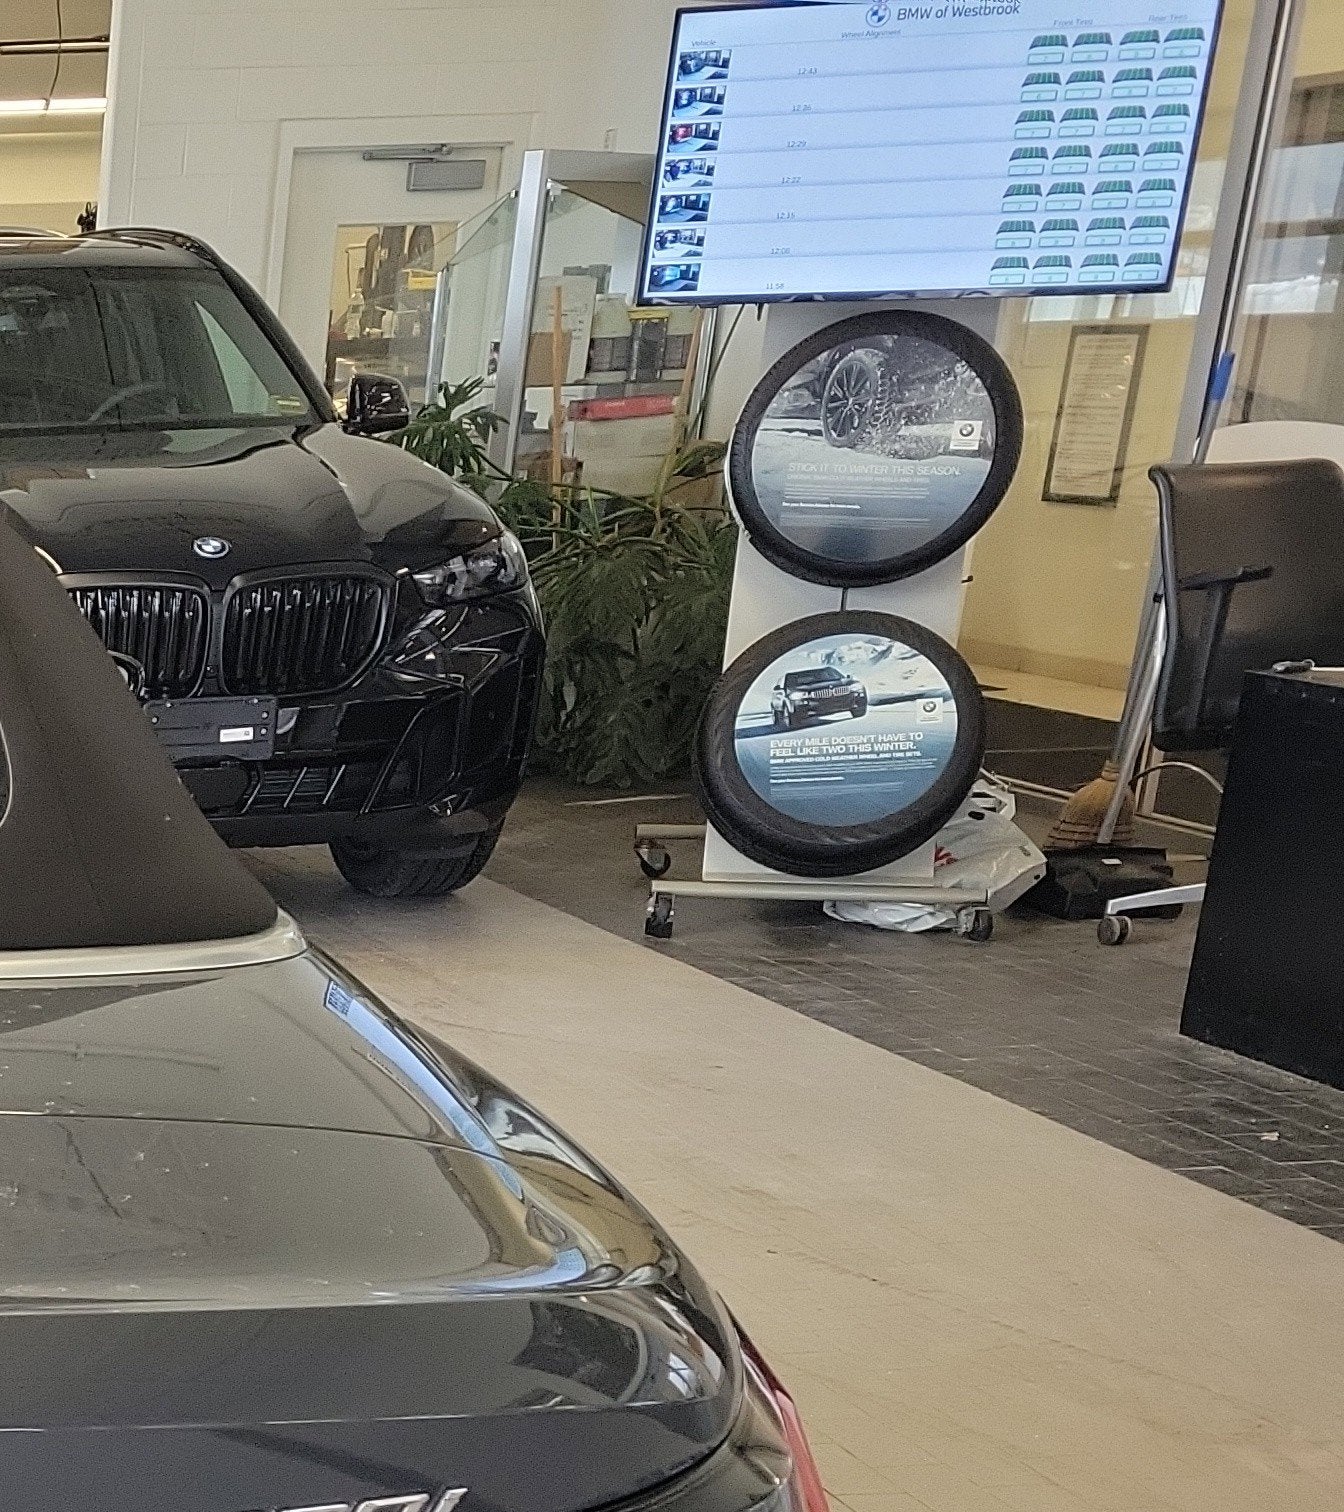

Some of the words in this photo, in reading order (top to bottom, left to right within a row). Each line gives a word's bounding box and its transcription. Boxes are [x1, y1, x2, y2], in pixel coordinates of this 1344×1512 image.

[897, 6, 933, 20] BMW
[935, 5, 949, 18] of
[952, 2, 1021, 17] Westbrook
[865, 29, 901, 38] Alignment
[834, 464, 847, 474] TO
[850, 464, 888, 474] WINTER
[891, 465, 914, 475] THIS
[917, 465, 962, 476] SEASON.
[770, 739, 803, 749] EVERY
[805, 737, 830, 747] MILE
[831, 735, 876, 745] DOESN'T
[878, 733, 907, 743] HAVE
[908, 731, 924, 741] TO
[770, 747, 795, 757] FEEL
[797, 746, 820, 756] LIKE
[821, 744, 846, 755] TWO
[848, 743, 872, 753] THIS
[874, 740, 917, 752] WINTER.
